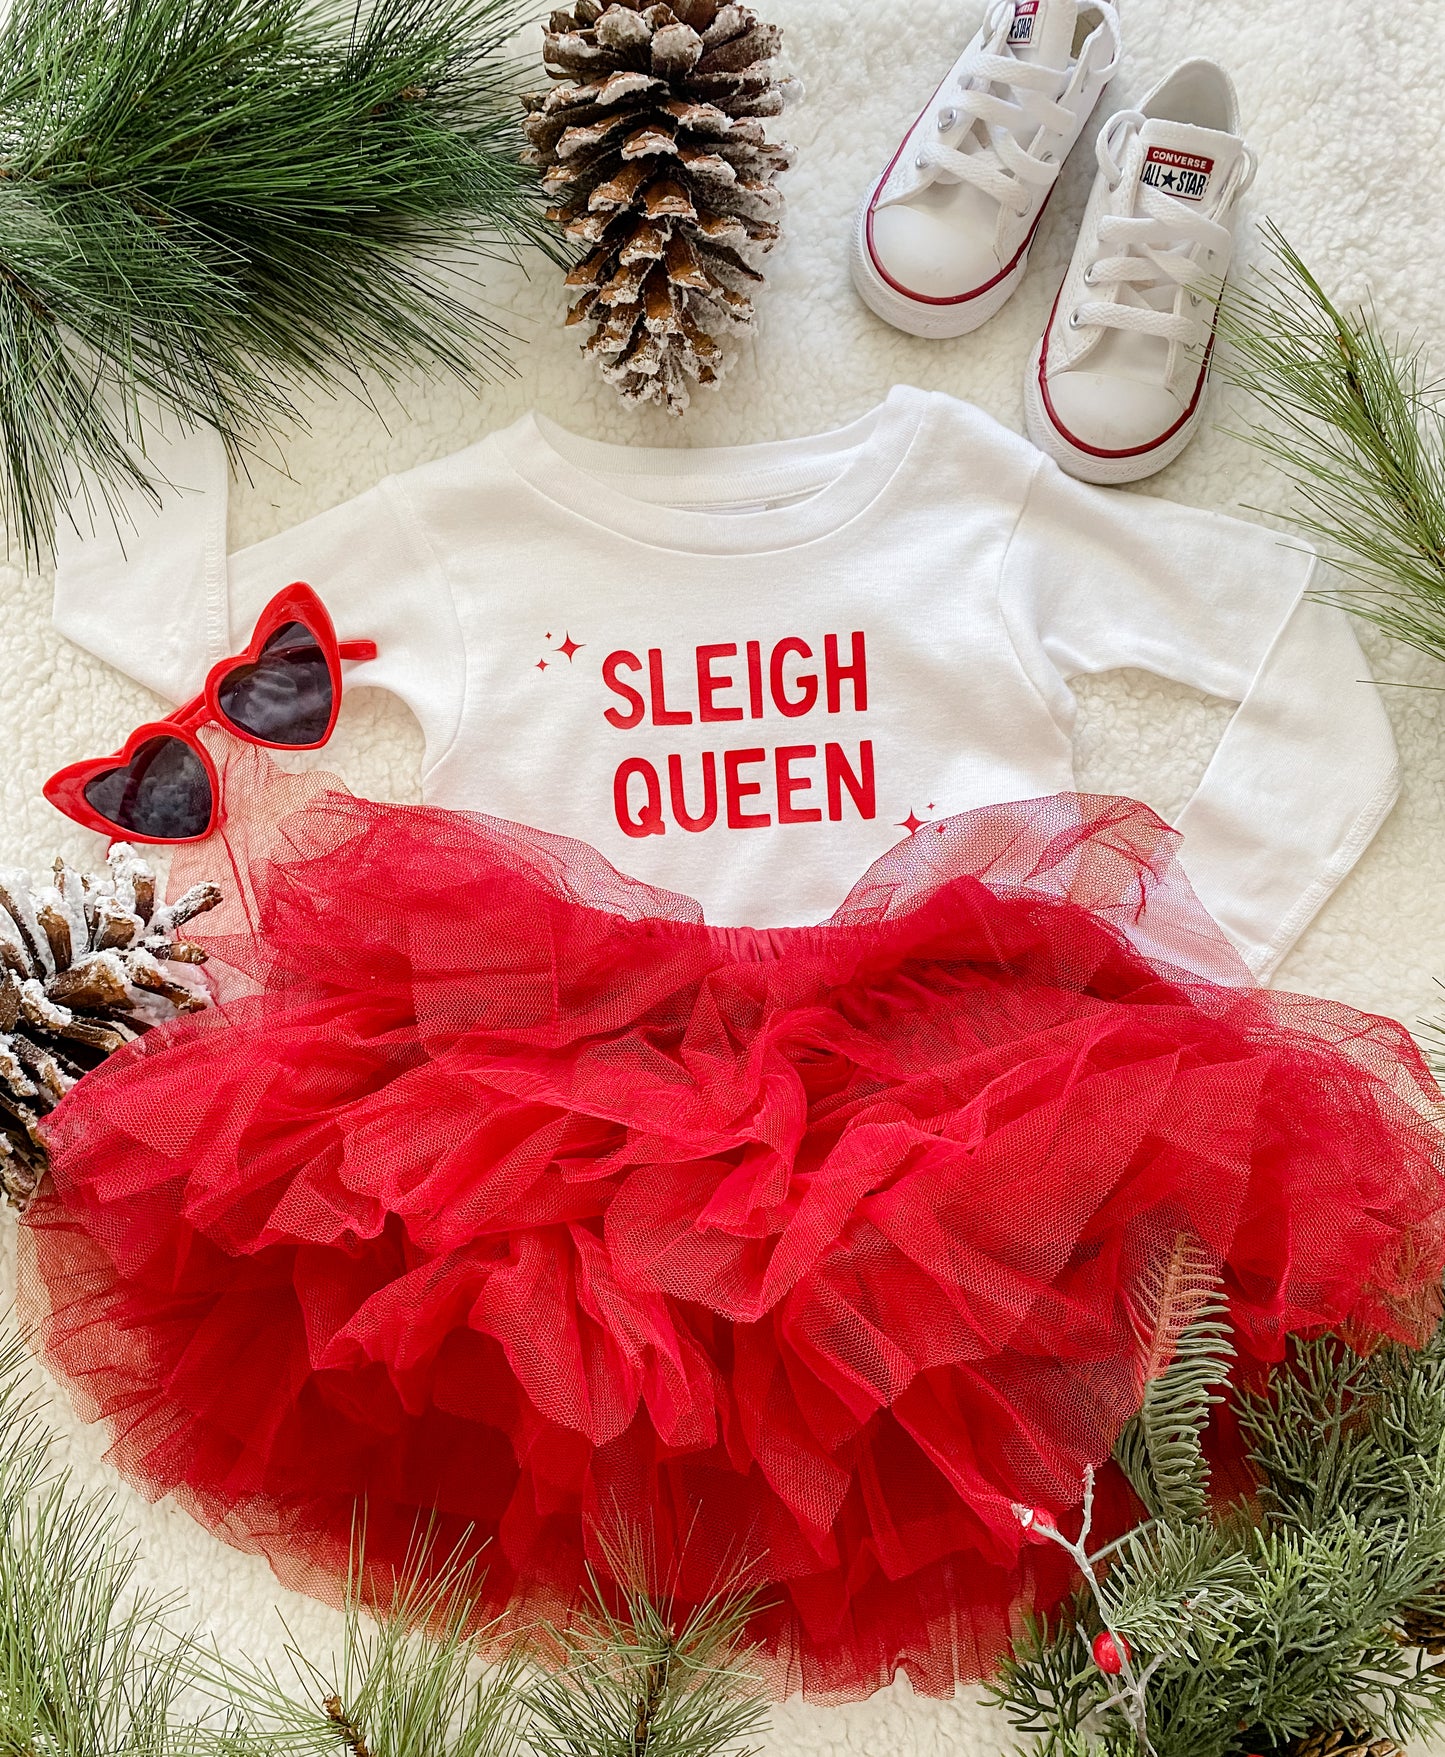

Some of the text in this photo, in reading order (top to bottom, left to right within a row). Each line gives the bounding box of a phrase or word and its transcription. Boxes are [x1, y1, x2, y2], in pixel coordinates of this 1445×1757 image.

[1014, 17, 1033, 39] STAR
[1152, 150, 1207, 170] CONVERSE
[1142, 163, 1207, 196] ALL STAR
[602, 631, 868, 730] SLEIGH
[613, 740, 876, 838] QUEEN
